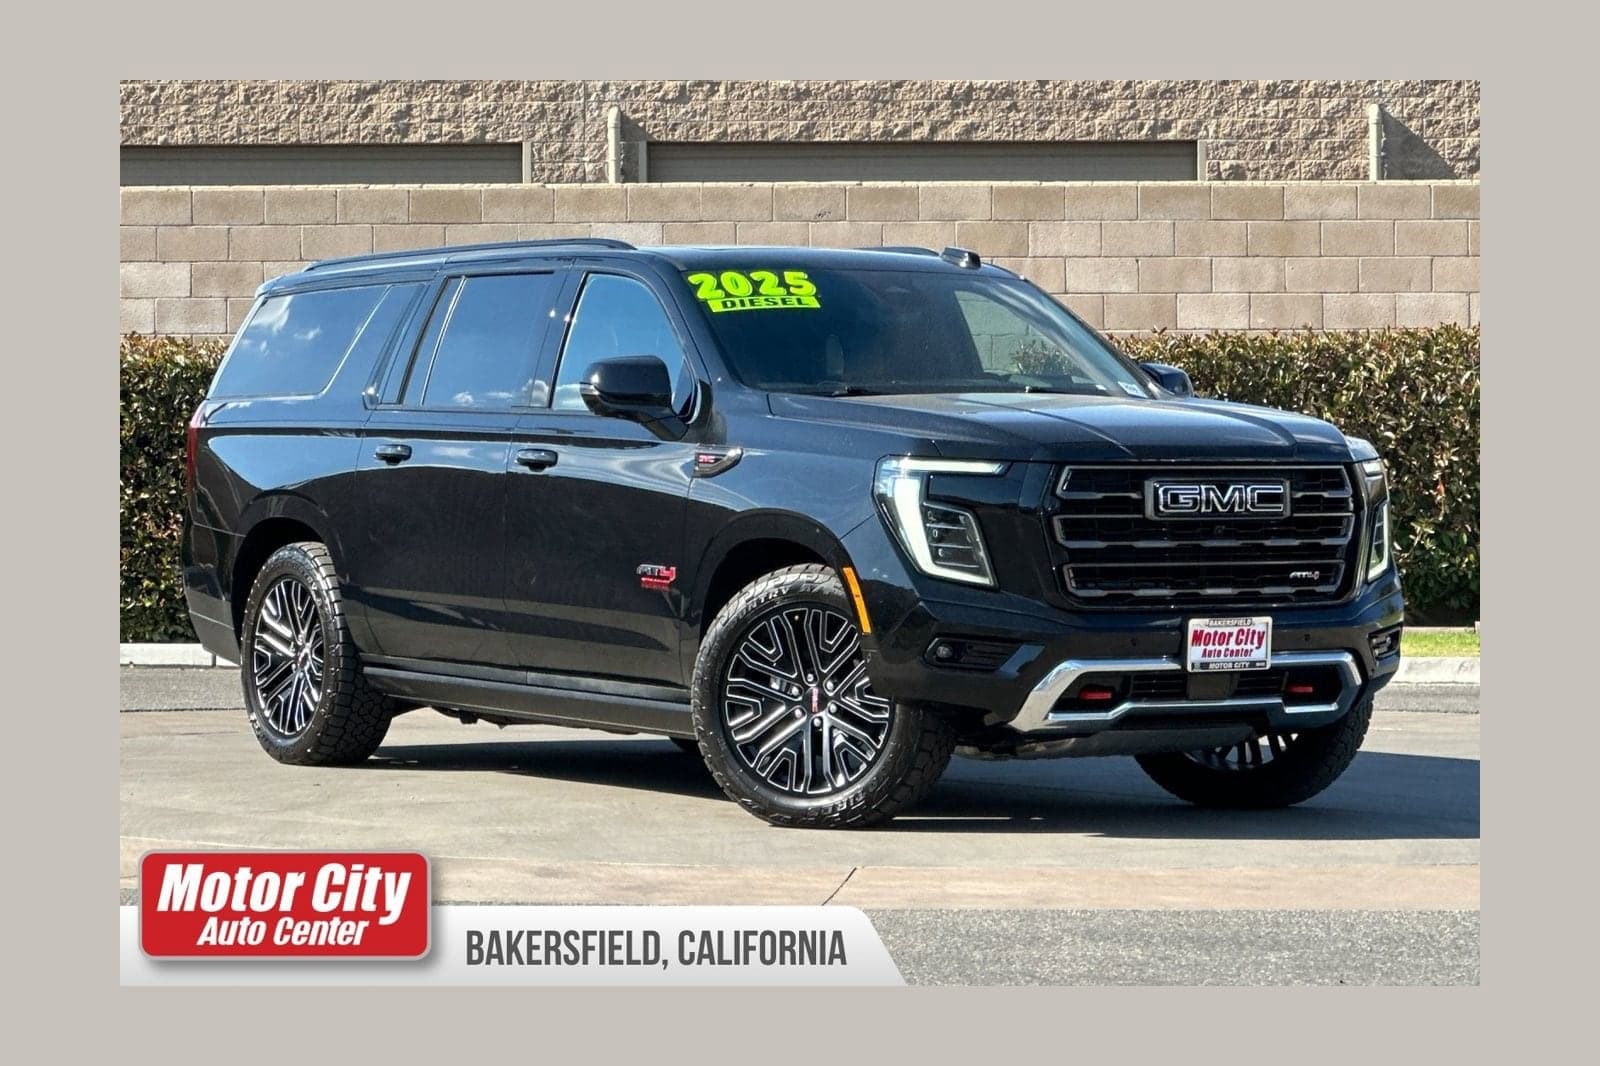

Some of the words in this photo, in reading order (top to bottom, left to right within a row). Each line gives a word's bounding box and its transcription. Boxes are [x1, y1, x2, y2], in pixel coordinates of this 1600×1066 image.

[687, 270, 817, 300] 2025
[721, 296, 810, 310] DIESEL
[1158, 484, 1283, 514] GMC
[1191, 628, 1234, 647] Motor
[1234, 627, 1266, 650] City
[1201, 648, 1222, 658] Auto
[1223, 647, 1254, 658] Center
[1208, 662, 1233, 670] MOTOR
[1234, 661, 1250, 670] CITY
